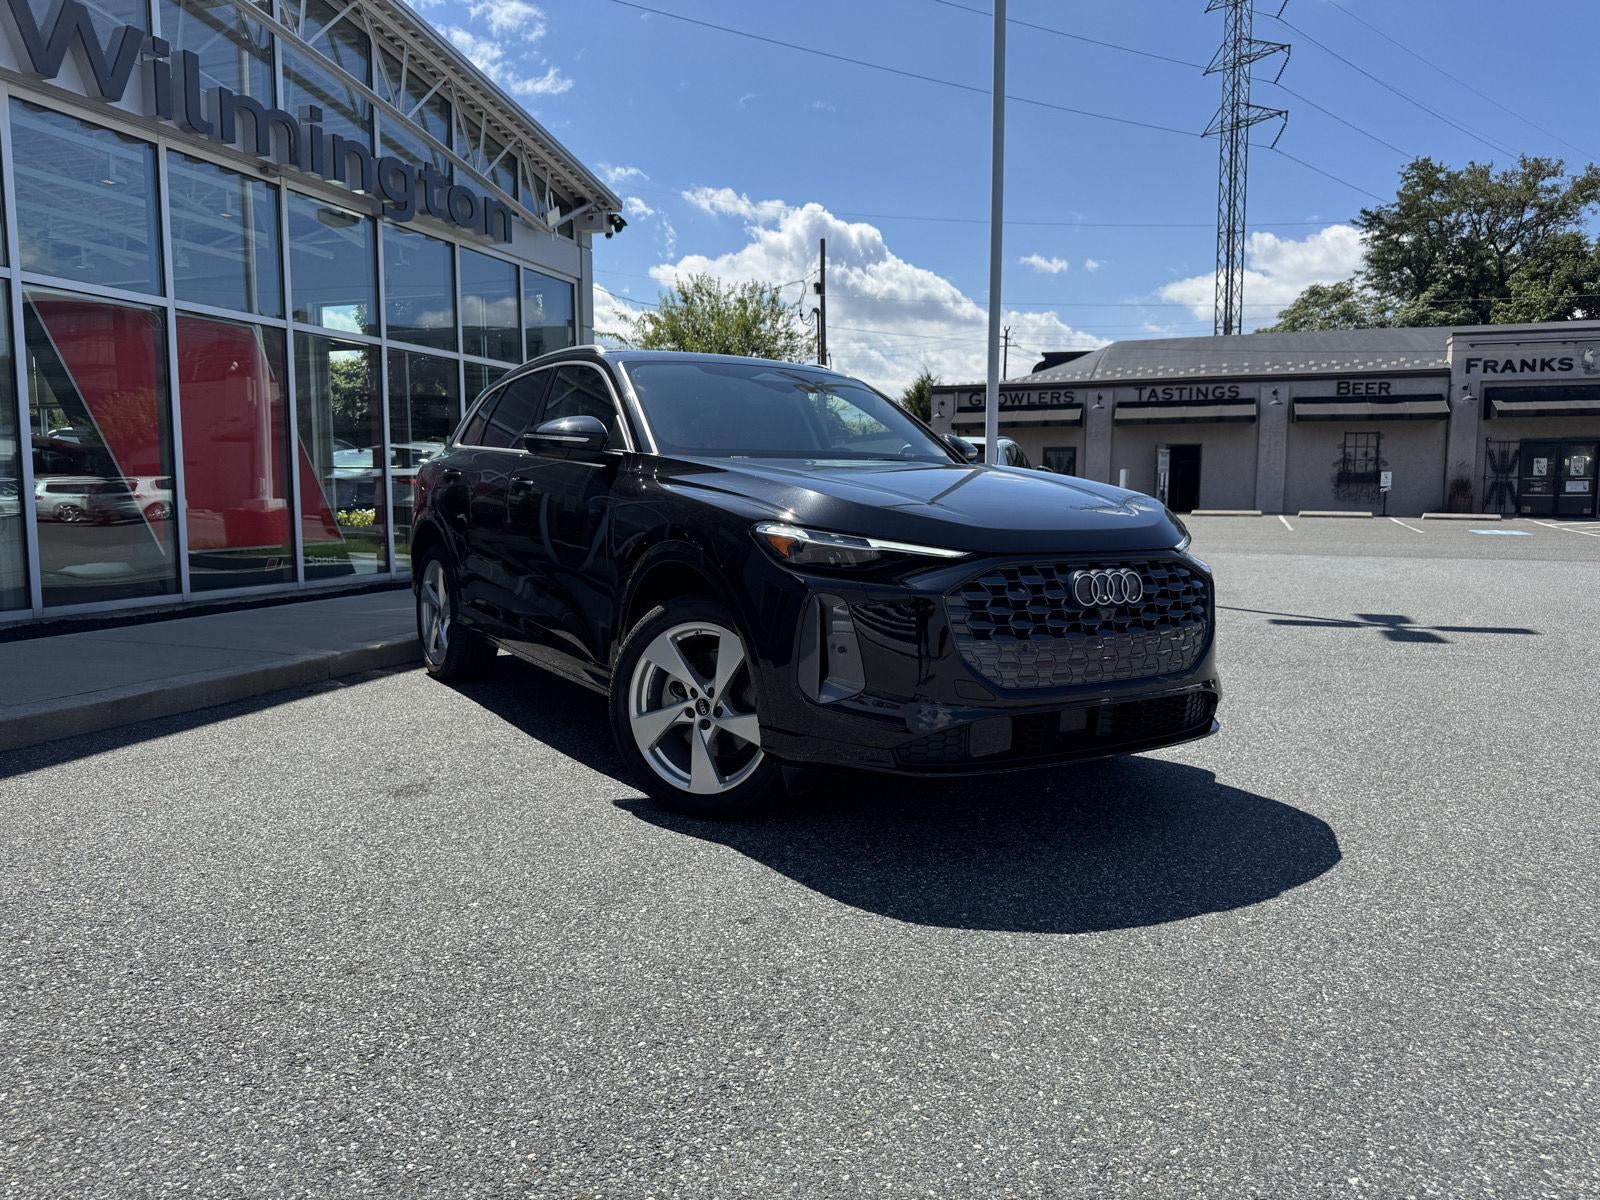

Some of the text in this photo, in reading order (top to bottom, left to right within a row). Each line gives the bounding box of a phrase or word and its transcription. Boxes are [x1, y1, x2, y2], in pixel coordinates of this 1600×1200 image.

[4, 0, 513, 244] Wilmington
[1465, 358, 1574, 374] FRANKS
[1134, 385, 1240, 402] TASTINGS
[1336, 381, 1391, 396] BEER
[969, 391, 1075, 407] GOWLERS
